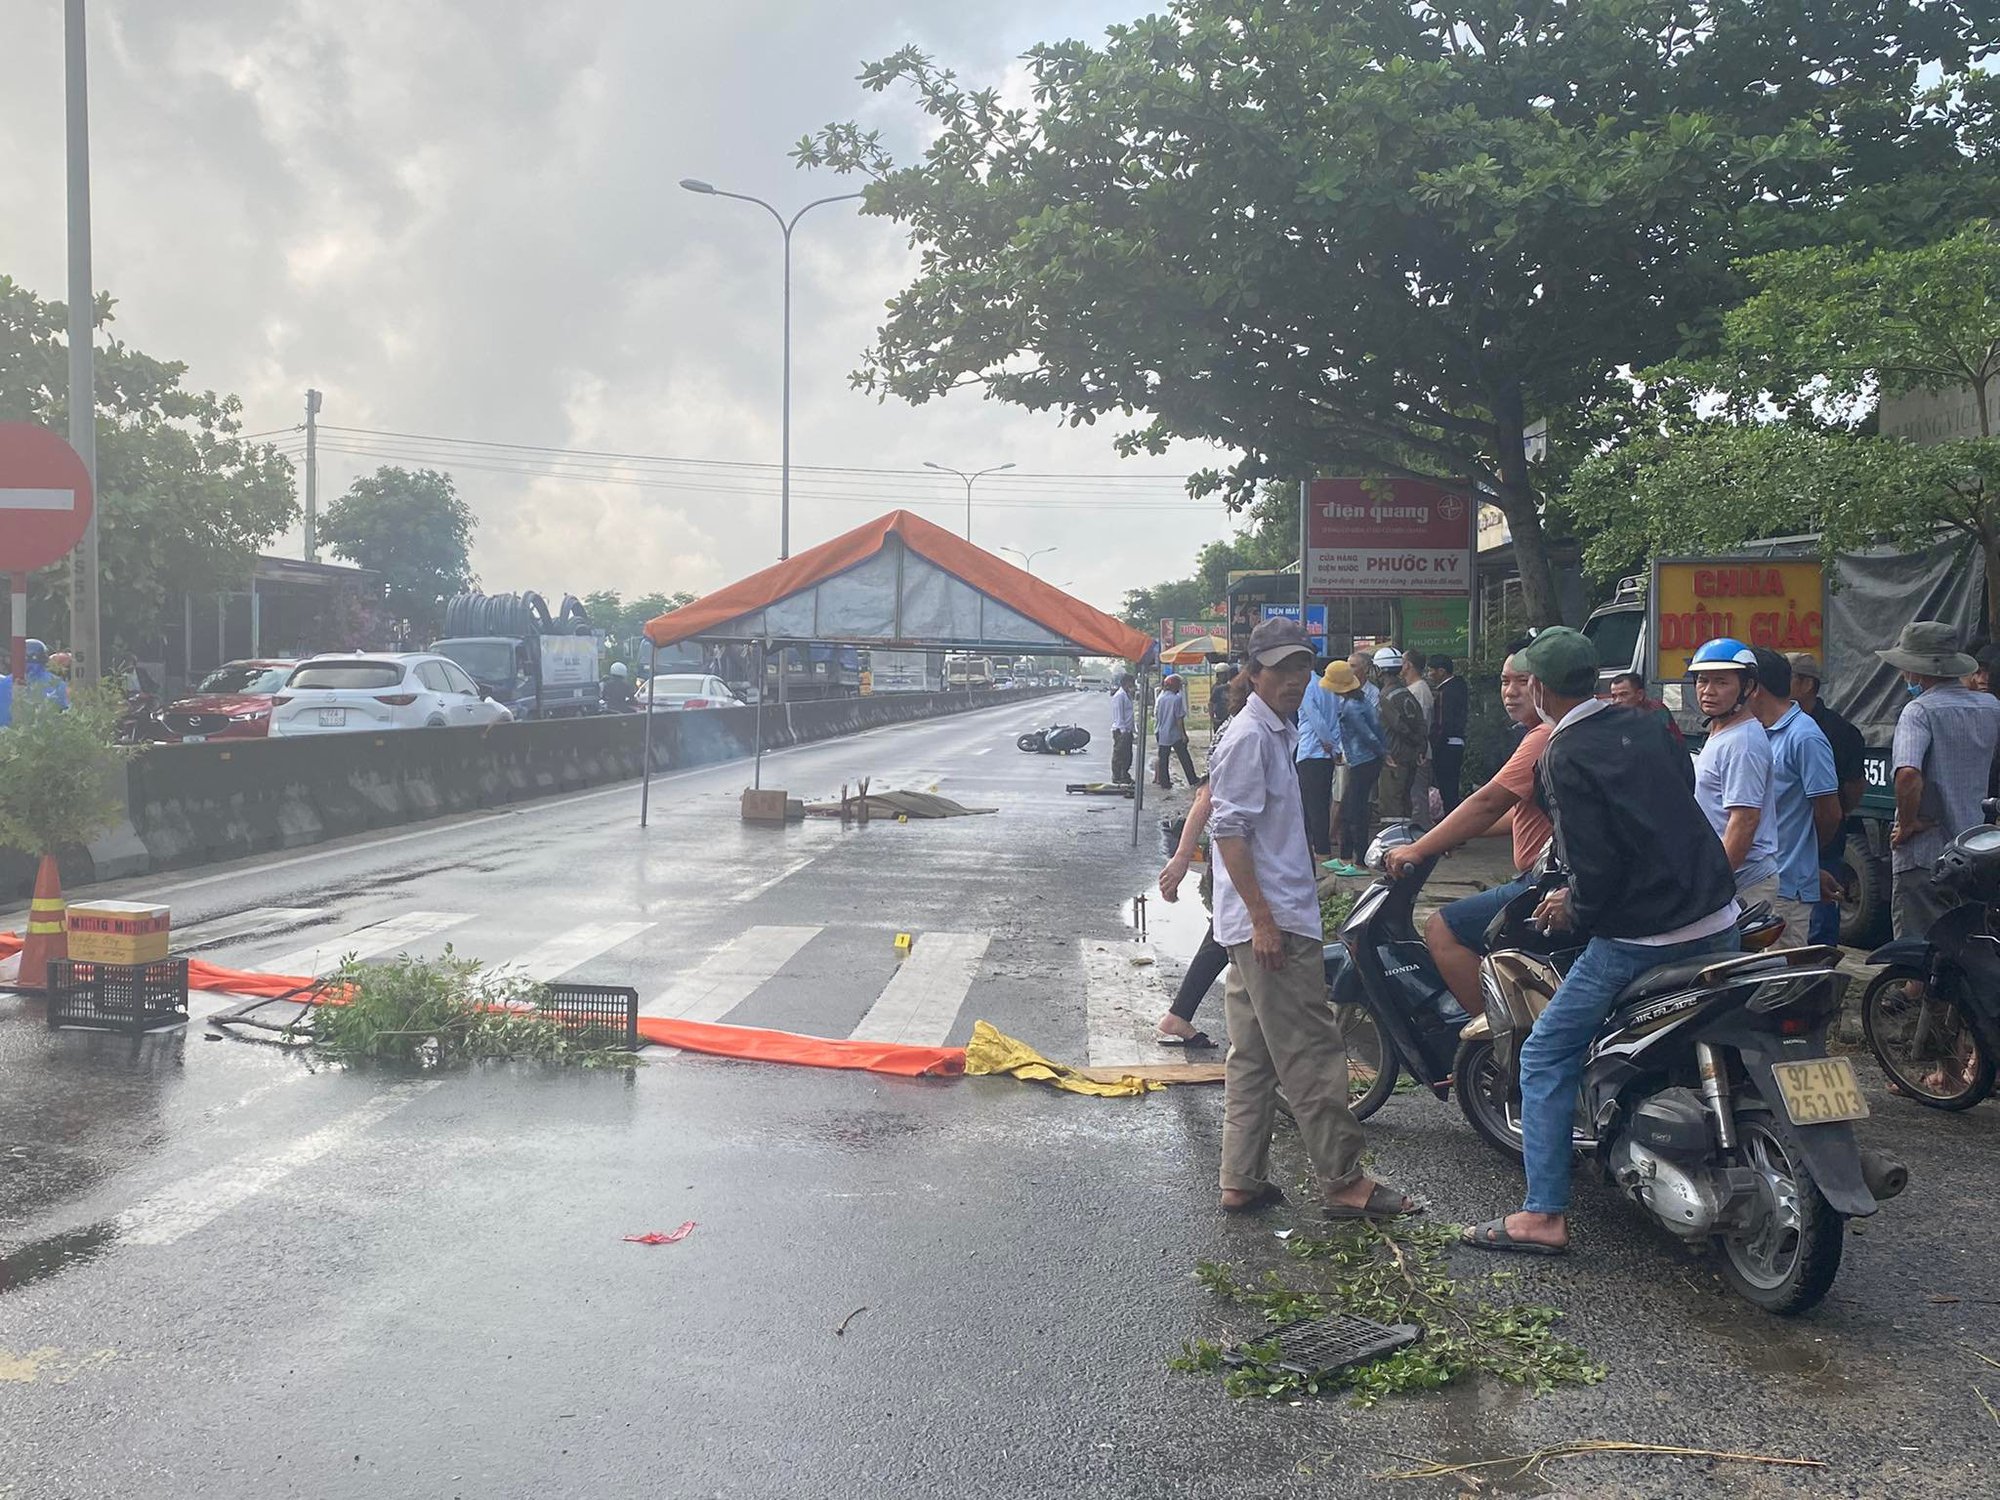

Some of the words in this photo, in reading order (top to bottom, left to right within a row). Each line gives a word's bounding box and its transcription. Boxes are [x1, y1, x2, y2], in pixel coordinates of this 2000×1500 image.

[1370, 506, 1429, 523] quang
[1366, 553, 1428, 572] PHƯỚC
[1384, 963, 1420, 977] HONDA
[1790, 1090, 1861, 1119] 253.03
